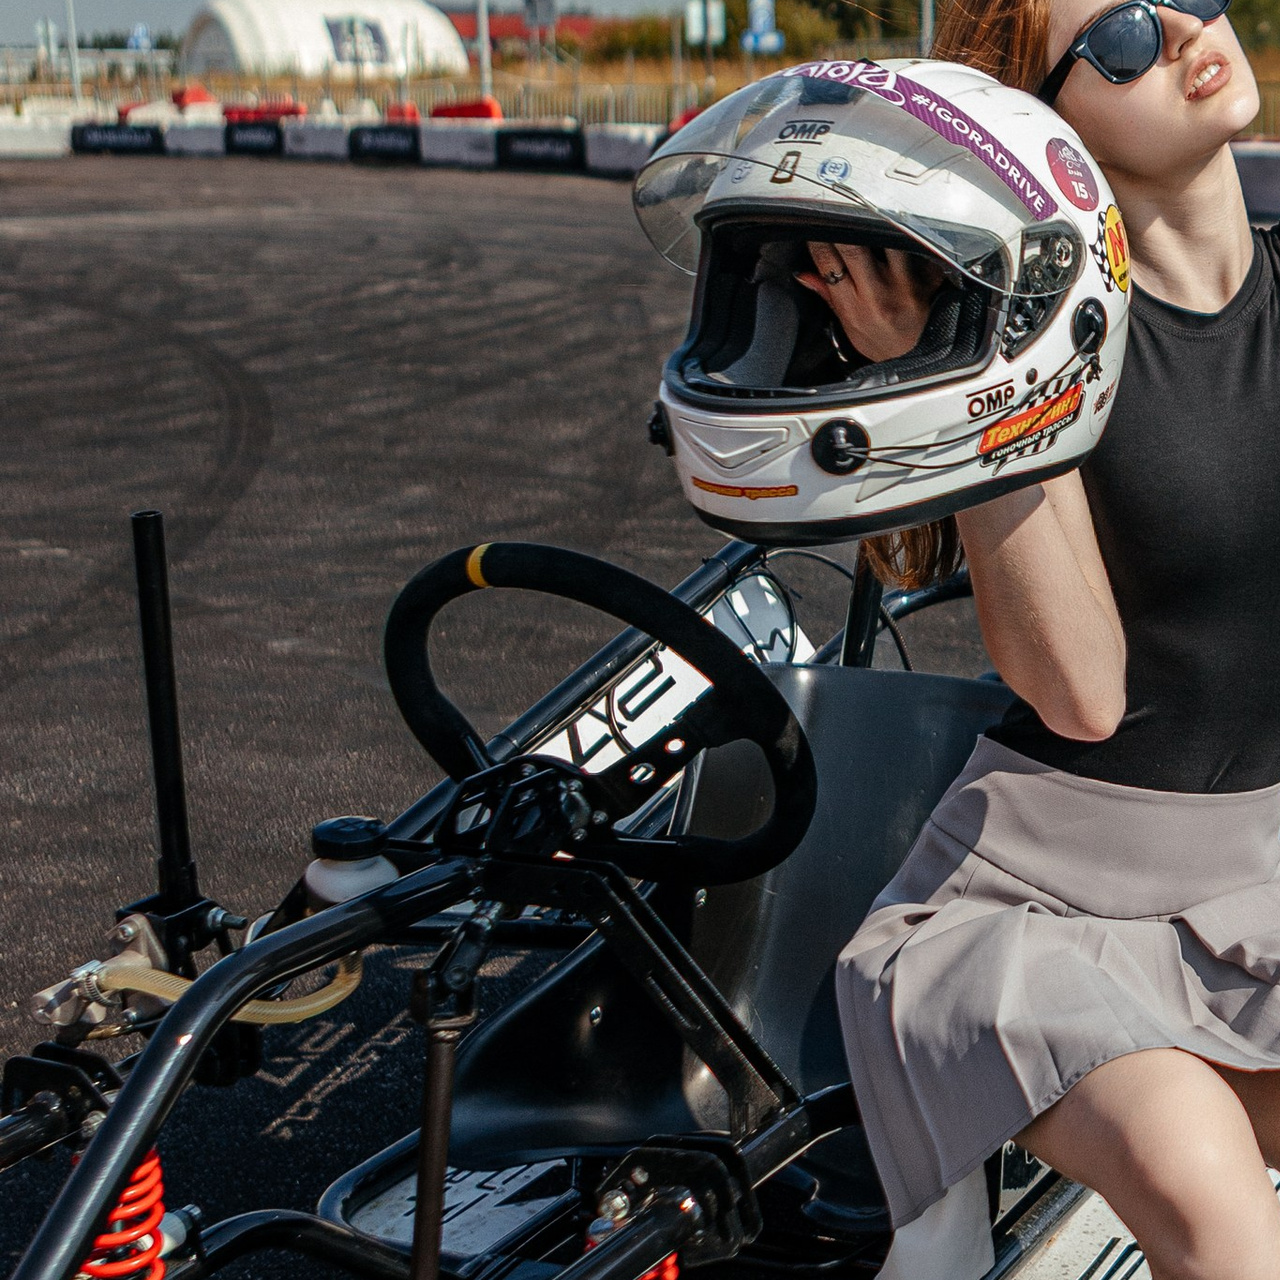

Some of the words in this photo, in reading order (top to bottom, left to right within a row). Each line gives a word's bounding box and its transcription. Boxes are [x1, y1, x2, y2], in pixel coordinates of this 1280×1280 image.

[777, 122, 832, 141] OMP
[911, 93, 1046, 213] #IGORADRIVE
[1072, 180, 1089, 200] 15
[967, 384, 1016, 418] OMP
